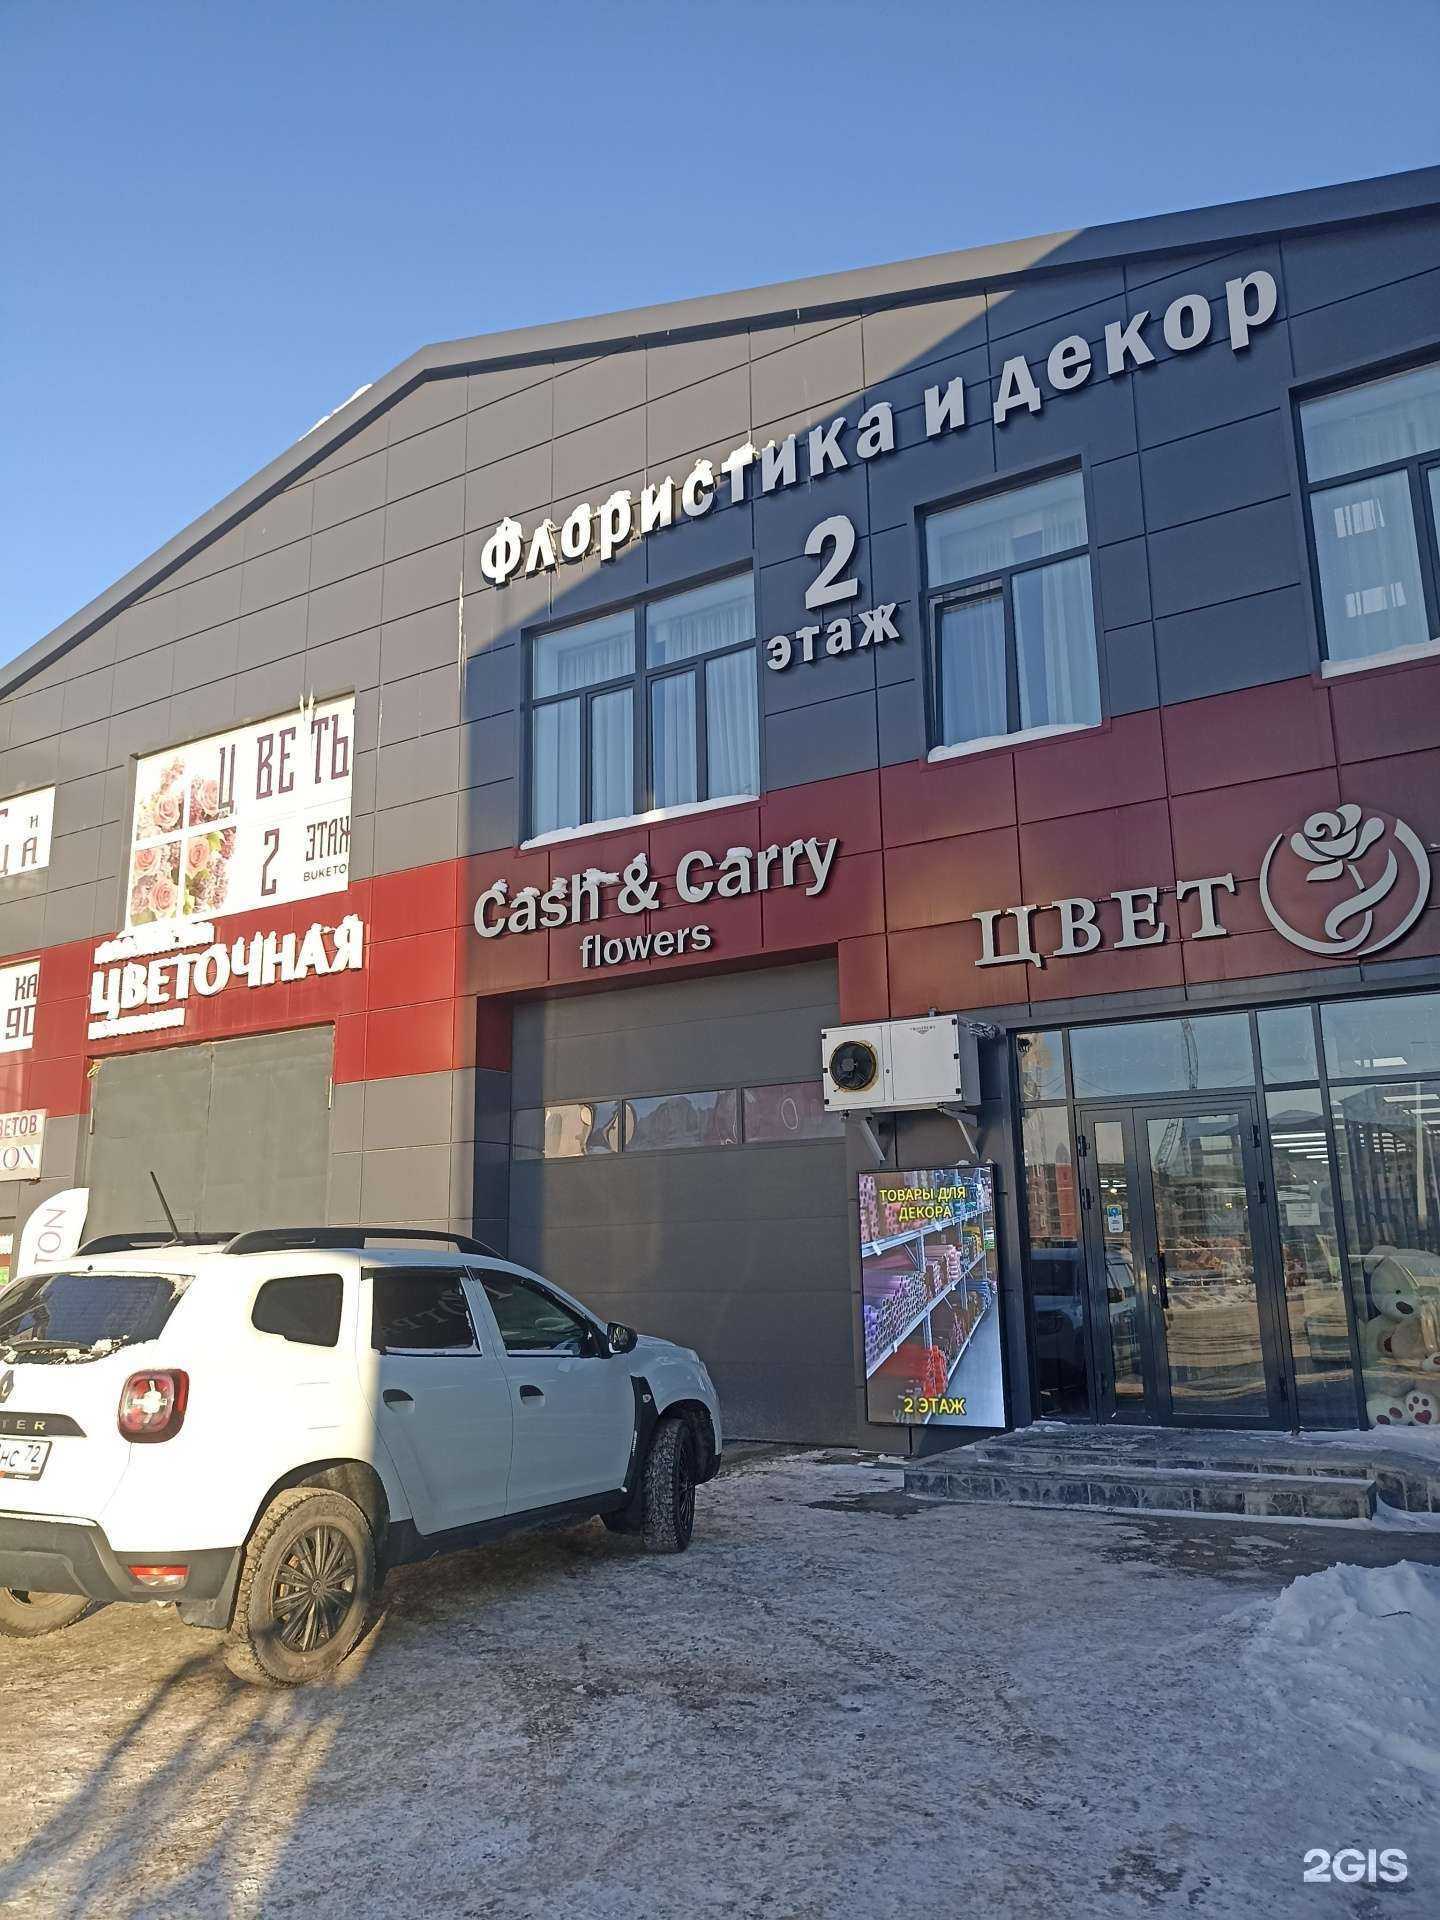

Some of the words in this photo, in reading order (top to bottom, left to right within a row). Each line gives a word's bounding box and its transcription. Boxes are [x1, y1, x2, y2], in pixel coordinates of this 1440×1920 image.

[480, 402, 895, 583] Флористика
[924, 376, 966, 437] и
[993, 270, 1277, 425] декор
[804, 514, 859, 610] 2
[766, 602, 901, 671] этаж
[261, 828, 280, 896] 2
[473, 873, 600, 938] Cash
[616, 852, 660, 914] &
[676, 838, 839, 903] Carry
[579, 923, 712, 969] flowers
[971, 873, 1236, 968] ЦВЕТ
[90, 914, 364, 1020] ЦВЕТОЧНАЯ
[880, 1188, 934, 1202] ТОВАРЫ
[938, 1186, 966, 1203] ДЛЯ
[899, 1205, 953, 1221] ДЕКОРА
[904, 1397, 914, 1413] 2
[918, 1397, 966, 1415] ЭТАЖ
